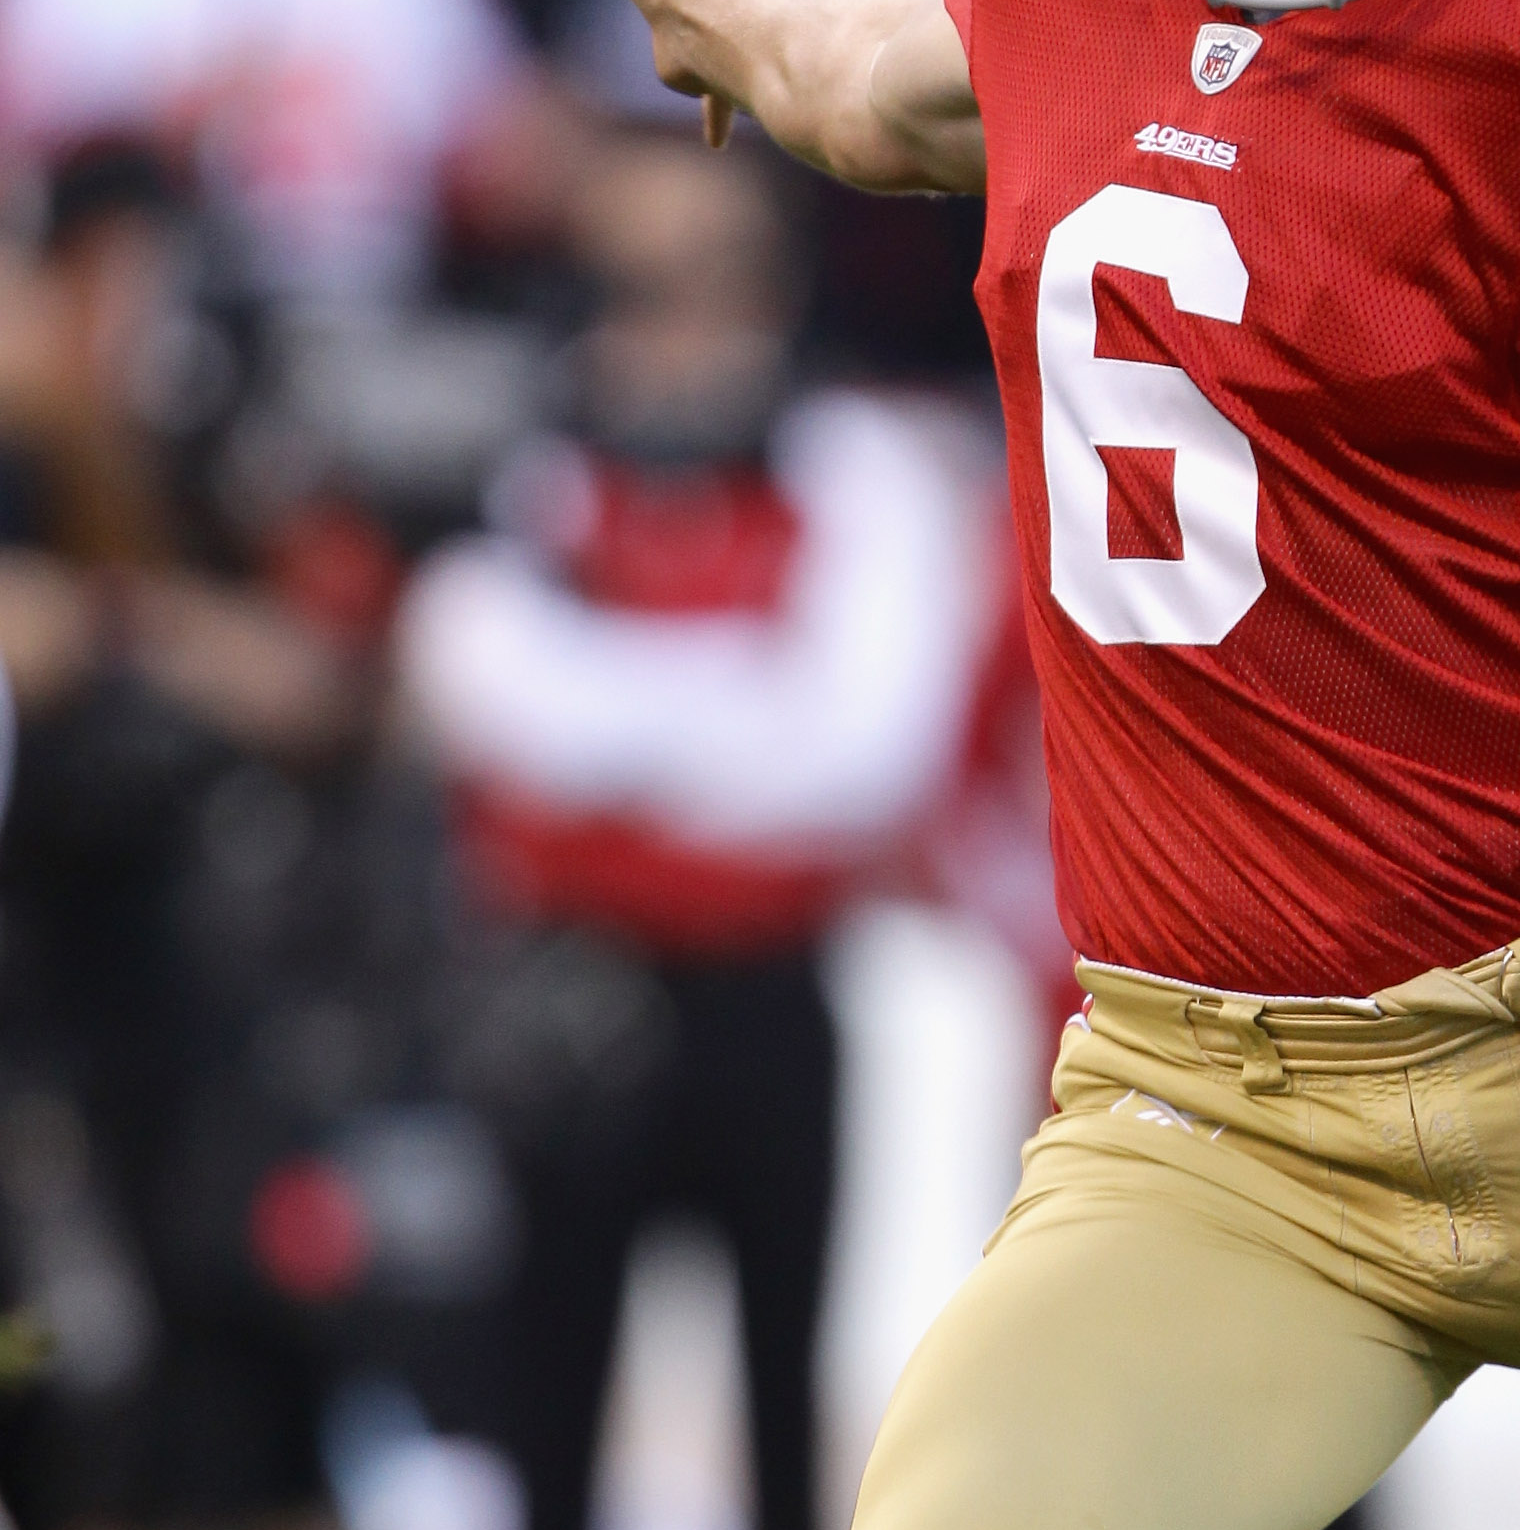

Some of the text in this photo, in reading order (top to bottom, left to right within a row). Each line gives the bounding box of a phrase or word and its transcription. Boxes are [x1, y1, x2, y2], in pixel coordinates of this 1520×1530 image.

[1202, 56, 1228, 79] NFL
[1134, 121, 1238, 169] 49ERS
[1036, 183, 1267, 646] 6
